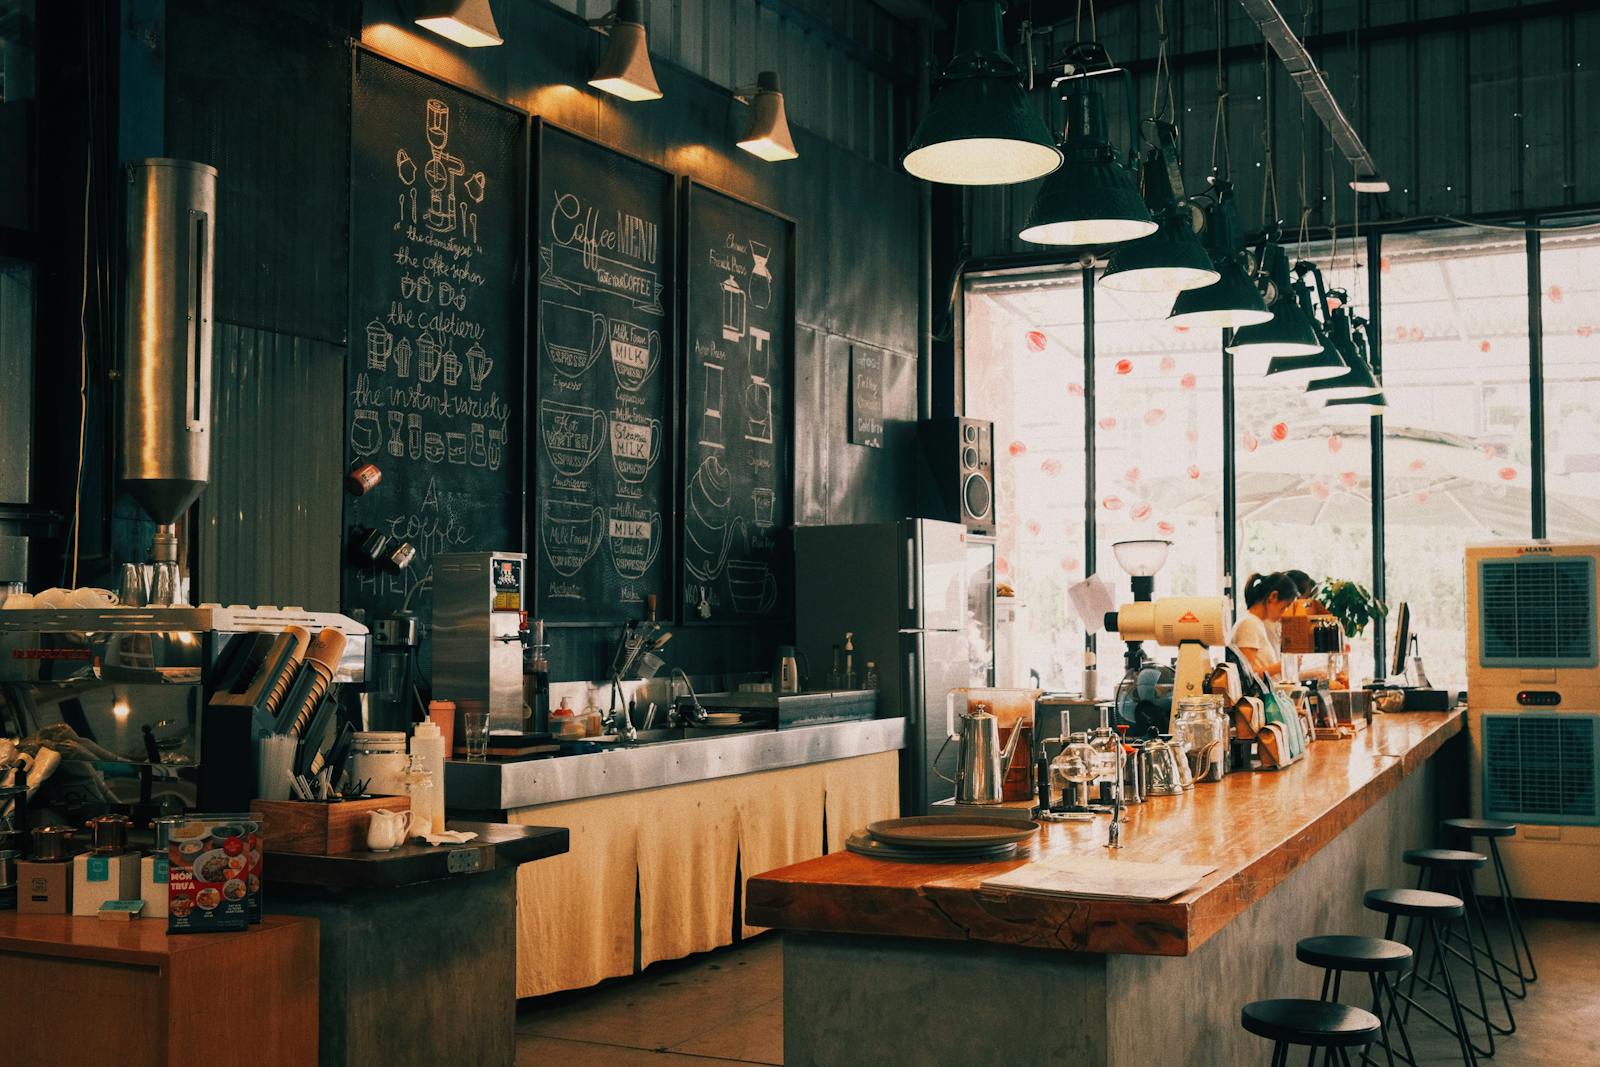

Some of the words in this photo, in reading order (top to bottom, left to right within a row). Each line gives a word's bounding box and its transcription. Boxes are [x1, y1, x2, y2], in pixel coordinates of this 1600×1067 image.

[616, 208, 658, 265] MENU
[393, 245, 420, 268] the
[386, 300, 416, 329] the
[615, 345, 645, 365] MILK
[351, 372, 385, 408] the
[385, 382, 454, 418] instant
[452, 391, 512, 446] variety
[615, 440, 645, 458] MILK
[614, 521, 644, 537] MILK
